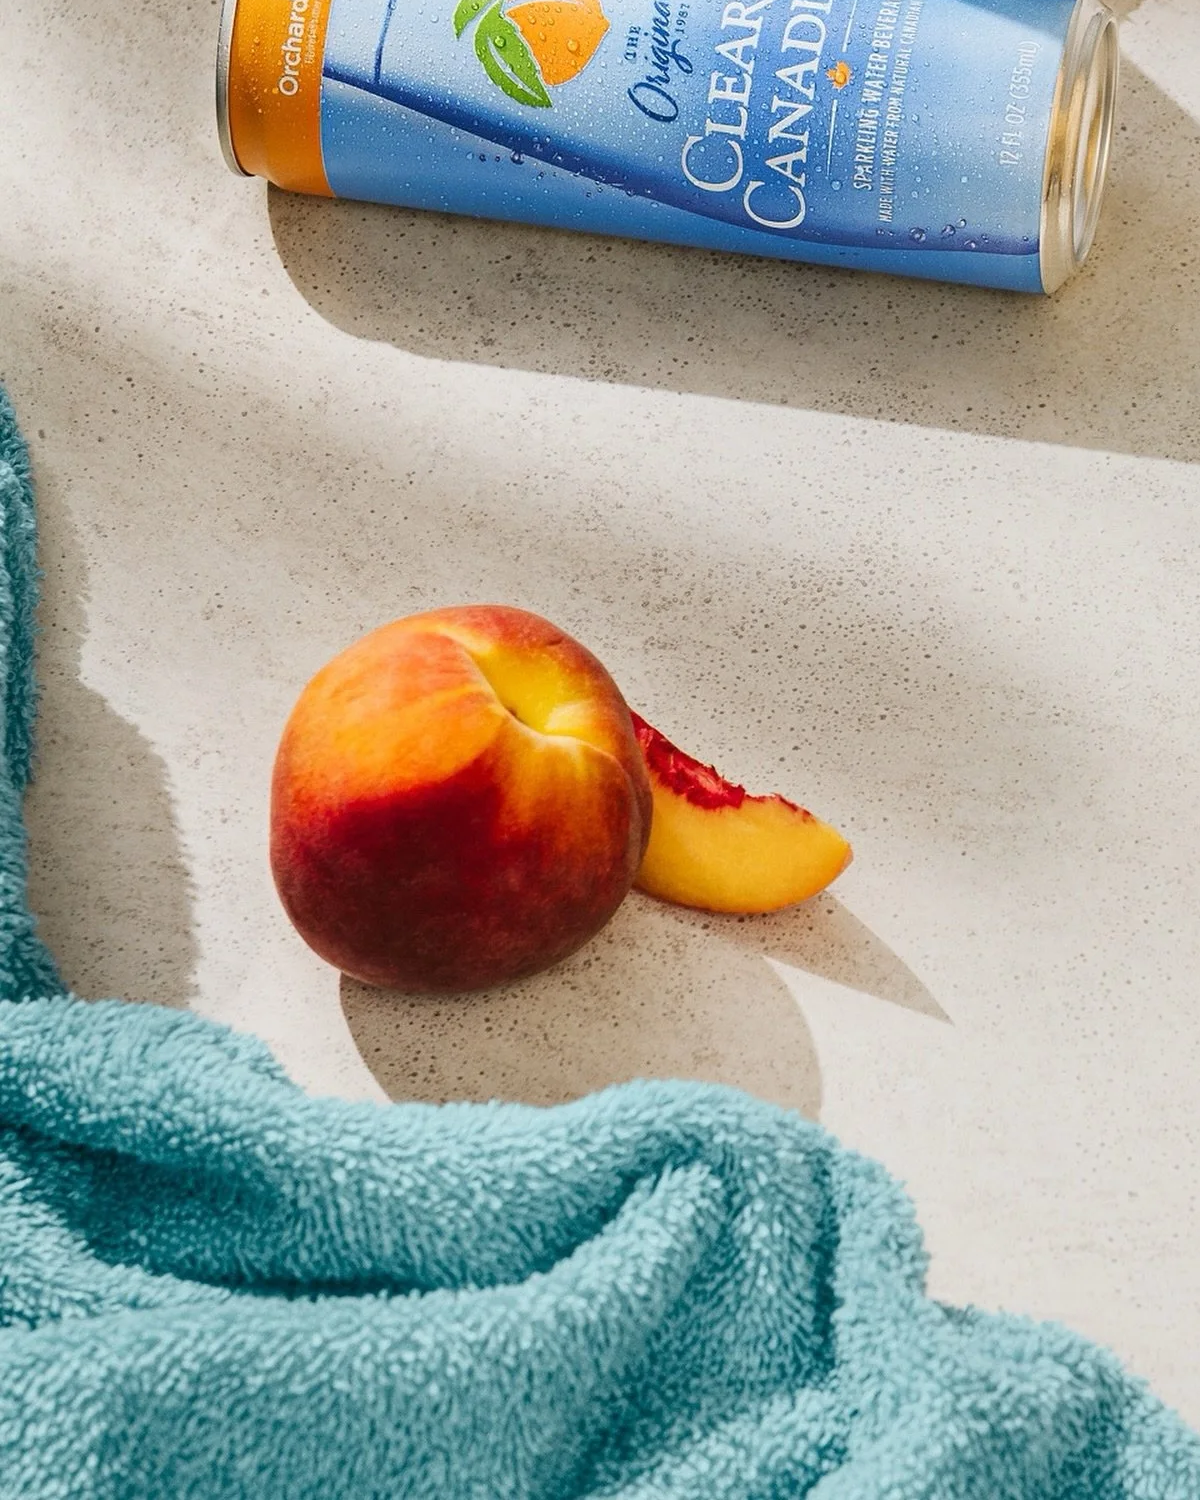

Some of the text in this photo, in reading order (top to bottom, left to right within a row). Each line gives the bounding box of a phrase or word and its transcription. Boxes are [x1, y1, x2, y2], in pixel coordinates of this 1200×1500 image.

[673, 3, 690, 34] 1987
[624, 25, 642, 62] THE
[861, 52, 888, 103] WATER
[890, 48, 912, 96] NATURAL
[885, 97, 903, 129] FROM
[1005, 103, 1026, 125] OZ
[853, 108, 880, 191] SPARKLING
[881, 130, 899, 166] WATER
[1000, 149, 1020, 166] 12
[880, 169, 895, 194] WITH
[879, 197, 893, 222] MADE
